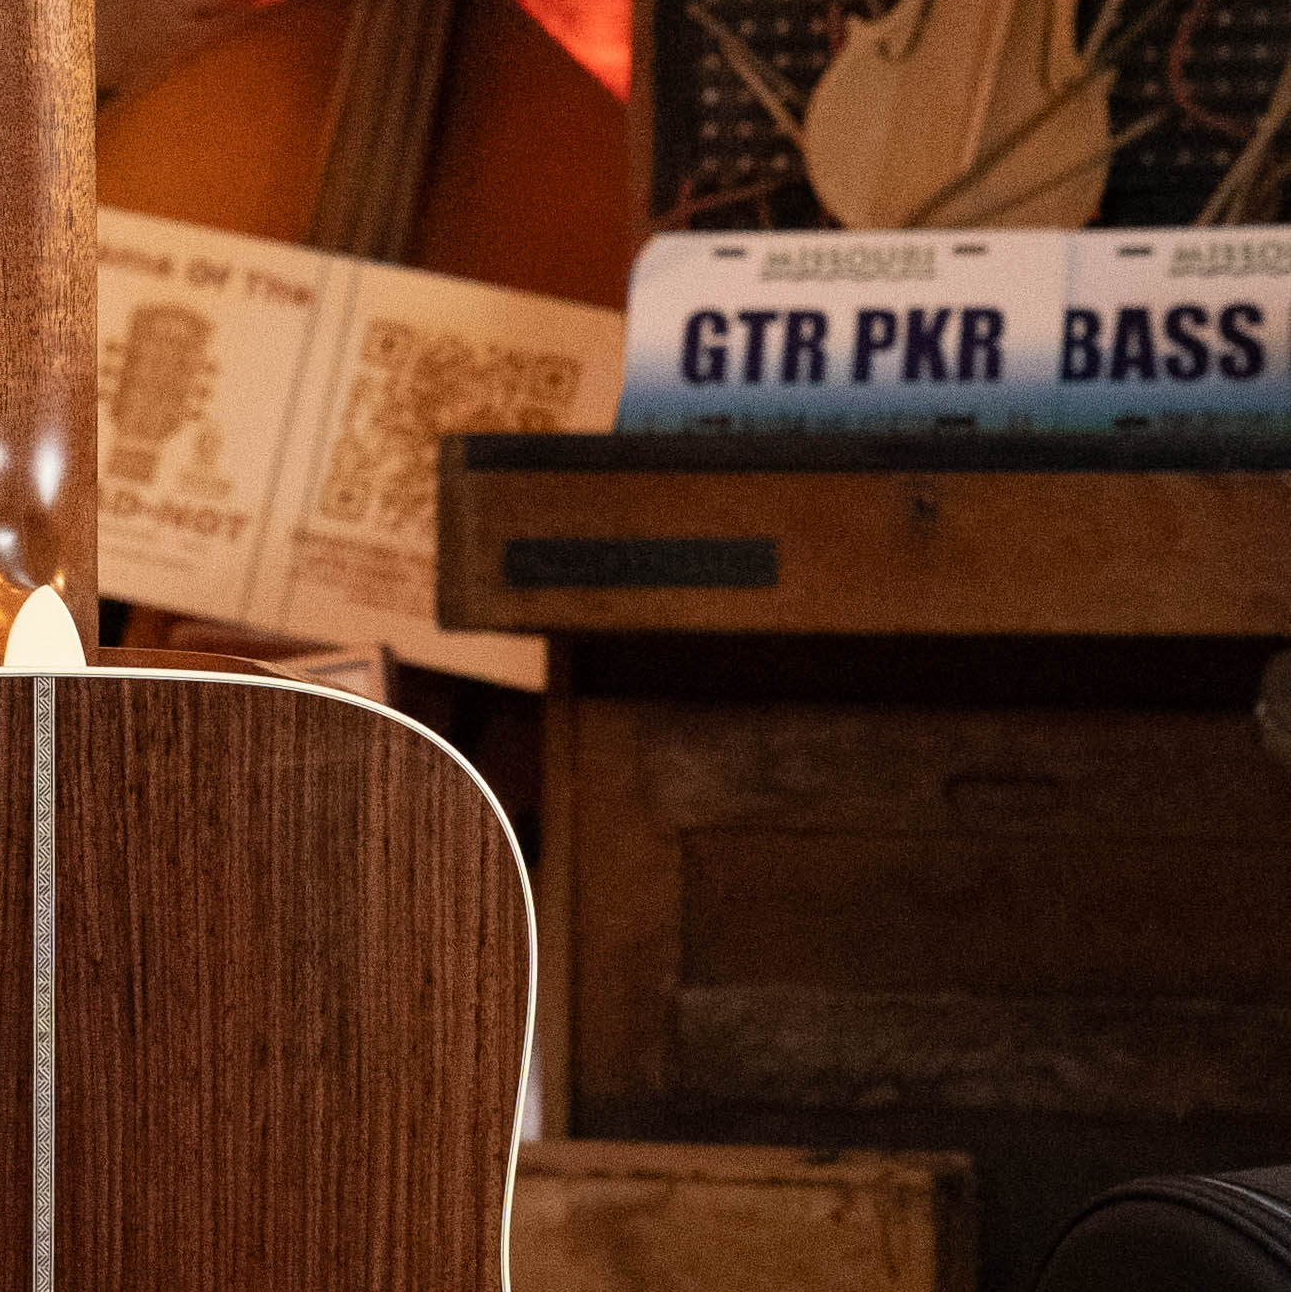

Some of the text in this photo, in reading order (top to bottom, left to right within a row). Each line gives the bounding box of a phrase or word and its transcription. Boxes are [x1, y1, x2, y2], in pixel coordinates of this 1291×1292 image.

[1170, 242, 1291, 277] MISSO
[680, 307, 1005, 385] GTR PKR
[1060, 303, 1265, 384] BASS
